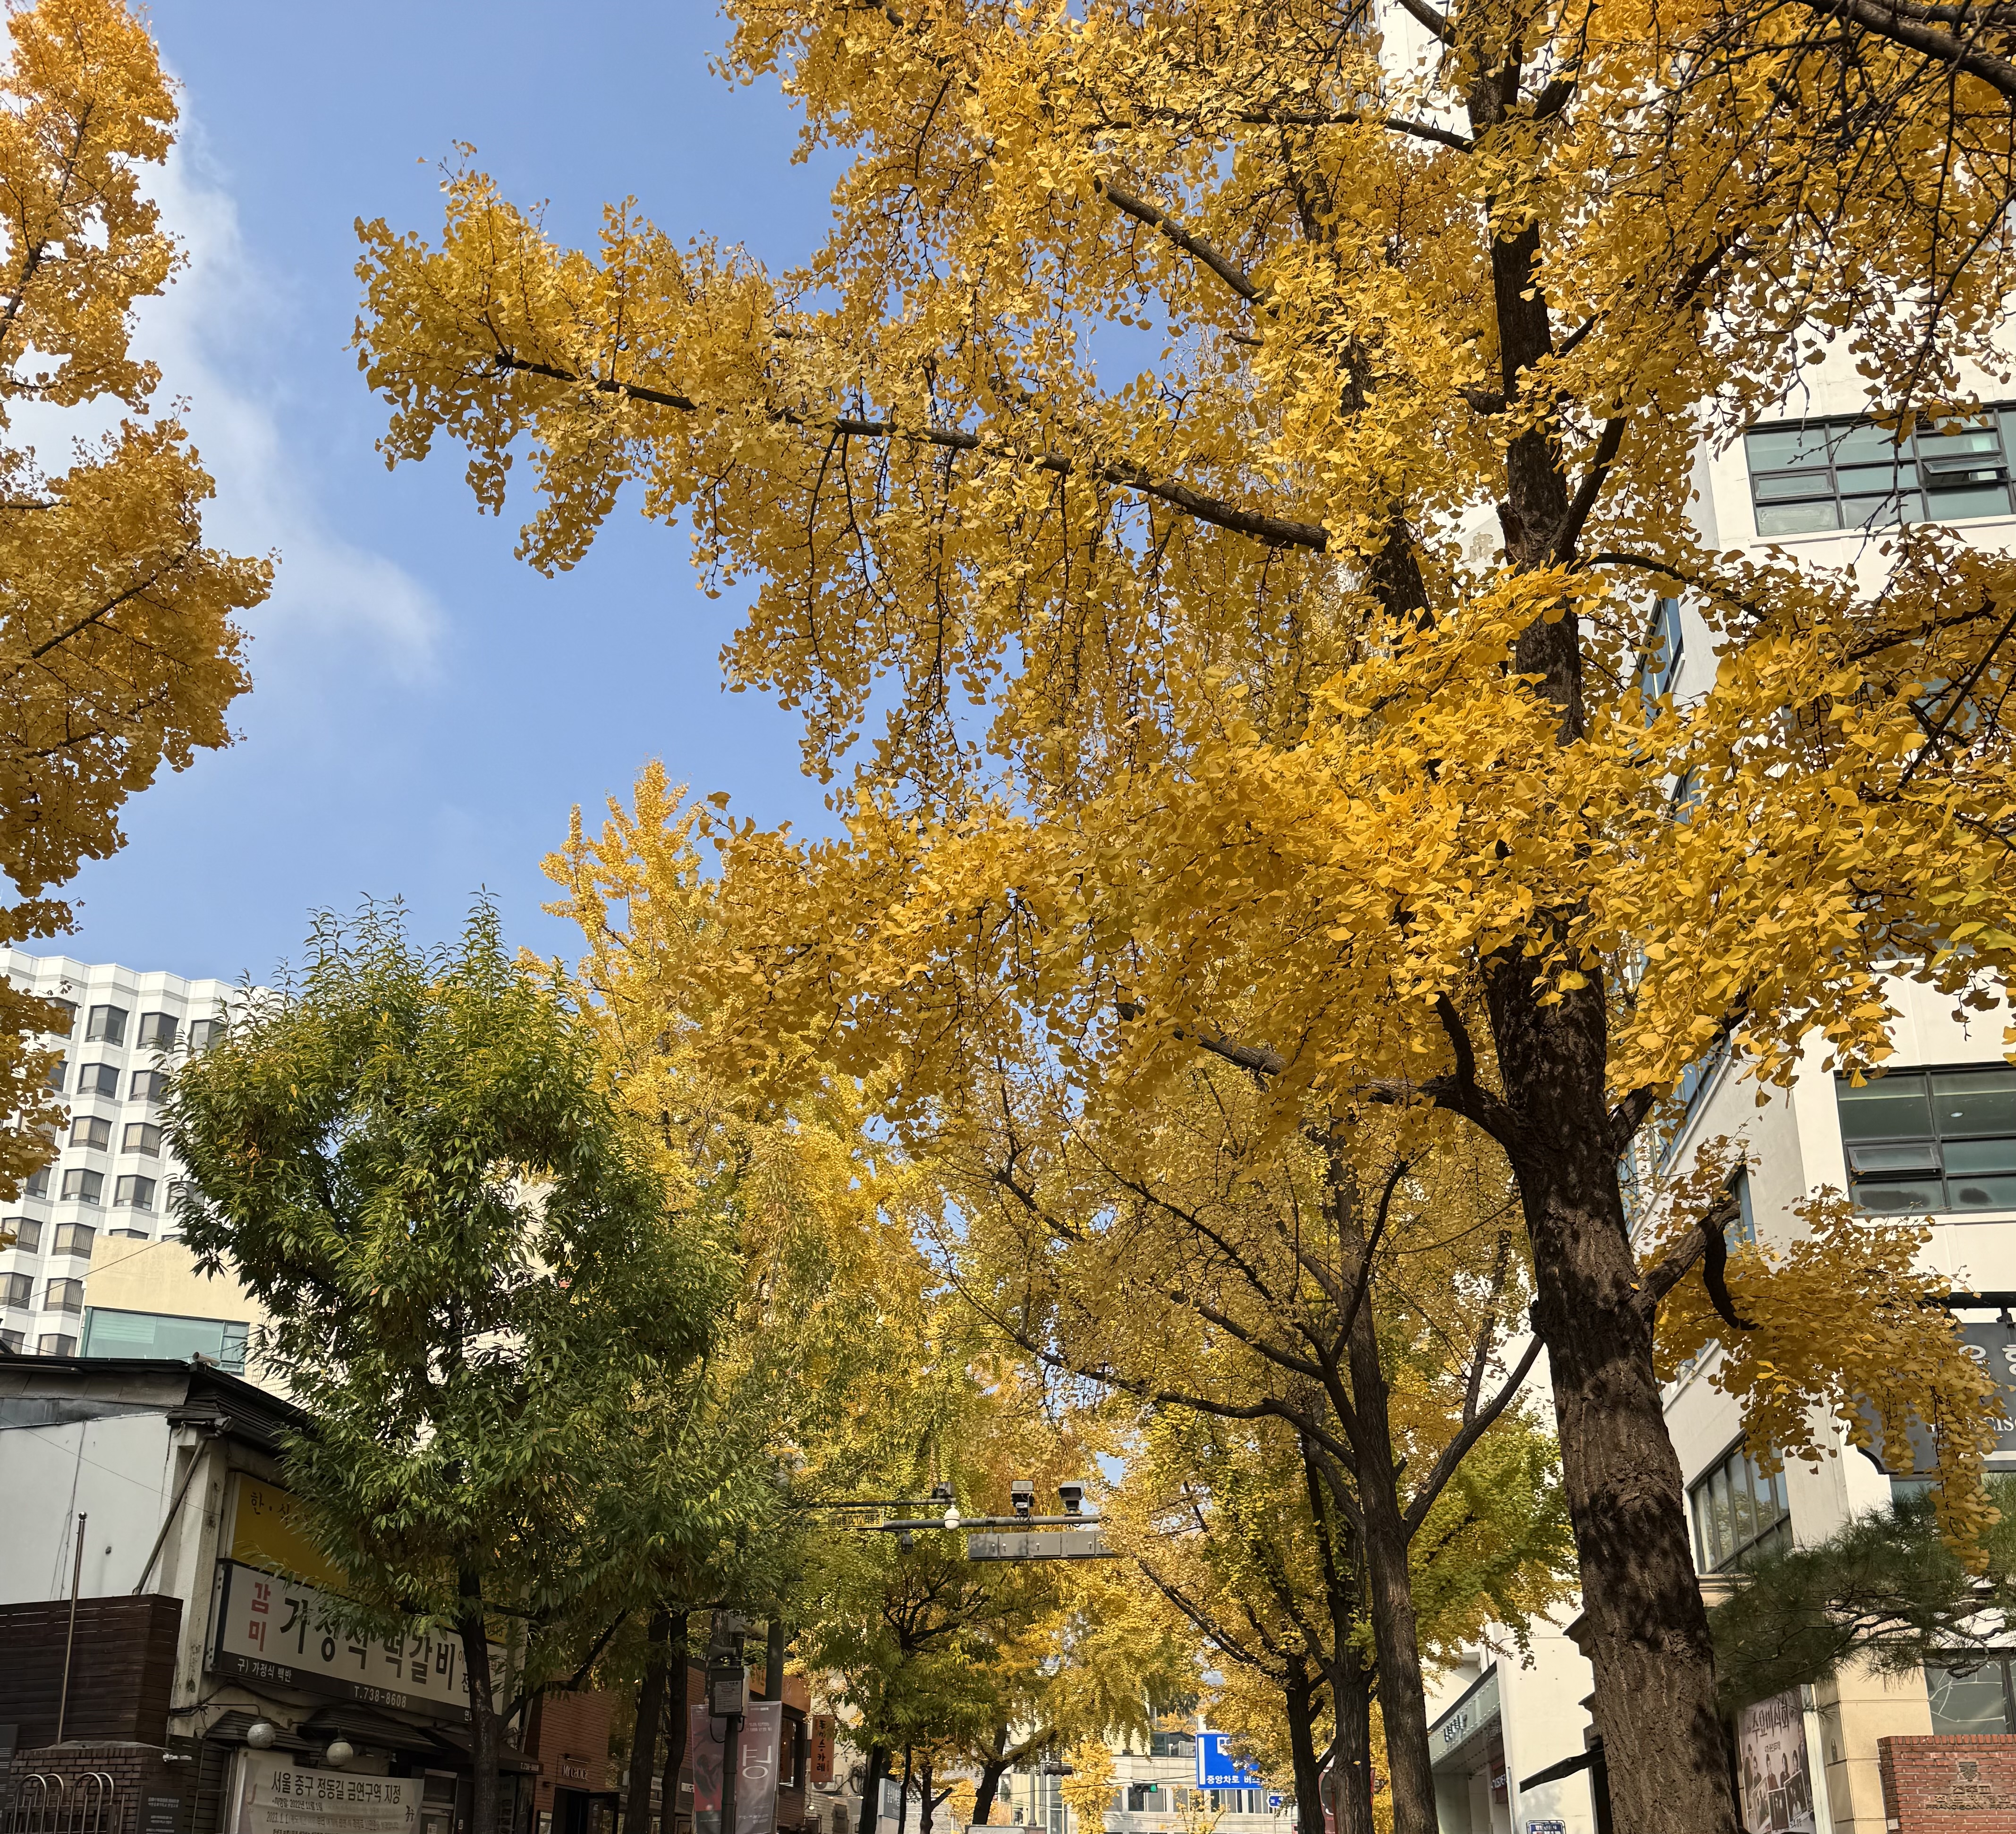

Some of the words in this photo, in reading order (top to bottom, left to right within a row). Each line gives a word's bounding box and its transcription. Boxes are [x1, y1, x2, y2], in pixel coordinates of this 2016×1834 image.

[848, 1515, 864, 1525] CCTV
[248, 1582, 271, 1652] 감미
[237, 1658, 249, 1673] 구)
[252, 1662, 275, 1679] 가정식
[278, 1667, 292, 1683] 백반
[355, 1686, 407, 1708] T.738-8608
[271, 1771, 291, 1794] 서울
[295, 1775, 313, 1797] 중구
[317, 1778, 344, 1800] 정동길
[347, 1782, 381, 1803] 금연구역
[384, 1784, 401, 1804] 지정
[1206, 1775, 1240, 1784] 중앙차로
